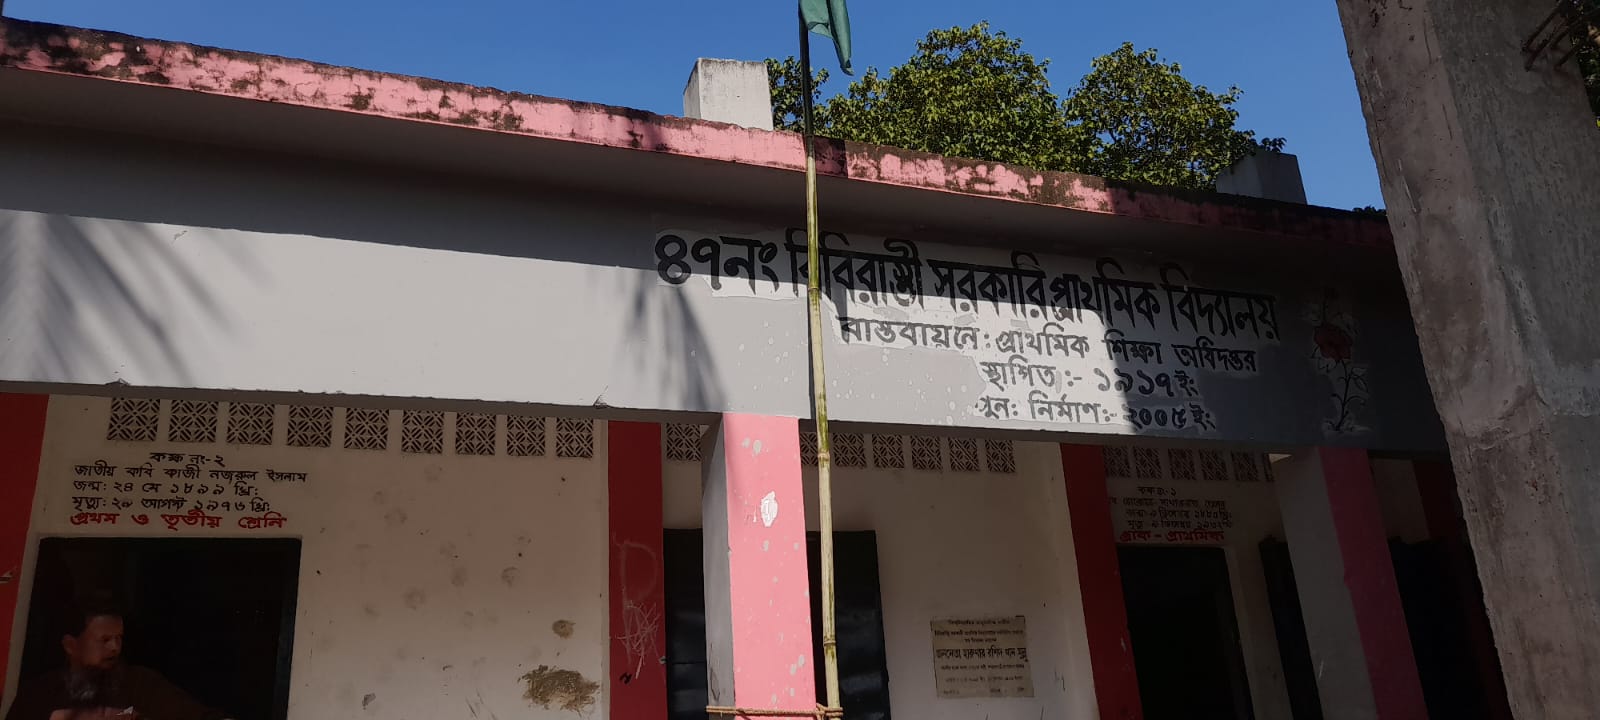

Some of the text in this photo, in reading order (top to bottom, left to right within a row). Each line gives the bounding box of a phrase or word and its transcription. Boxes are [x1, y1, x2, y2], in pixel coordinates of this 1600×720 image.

[1160, 262, 1281, 342] বিদ্যালয়
[997, 323, 1090, 359] প্রাথমিক
[1102, 328, 1162, 365] শিক্ষা
[150, 452, 185, 464] কক্ষ
[74, 460, 307, 485] জাতীয় কবি কাজী নজরুল ইসলাম
[113, 481, 134, 493] ২৪
[142, 482, 162, 493] মে
[170, 482, 225, 495] ১৮৯৯
[70, 511, 120, 527] প্রথম
[131, 513, 150, 527] ও
[160, 509, 223, 531] তৃতীয়
